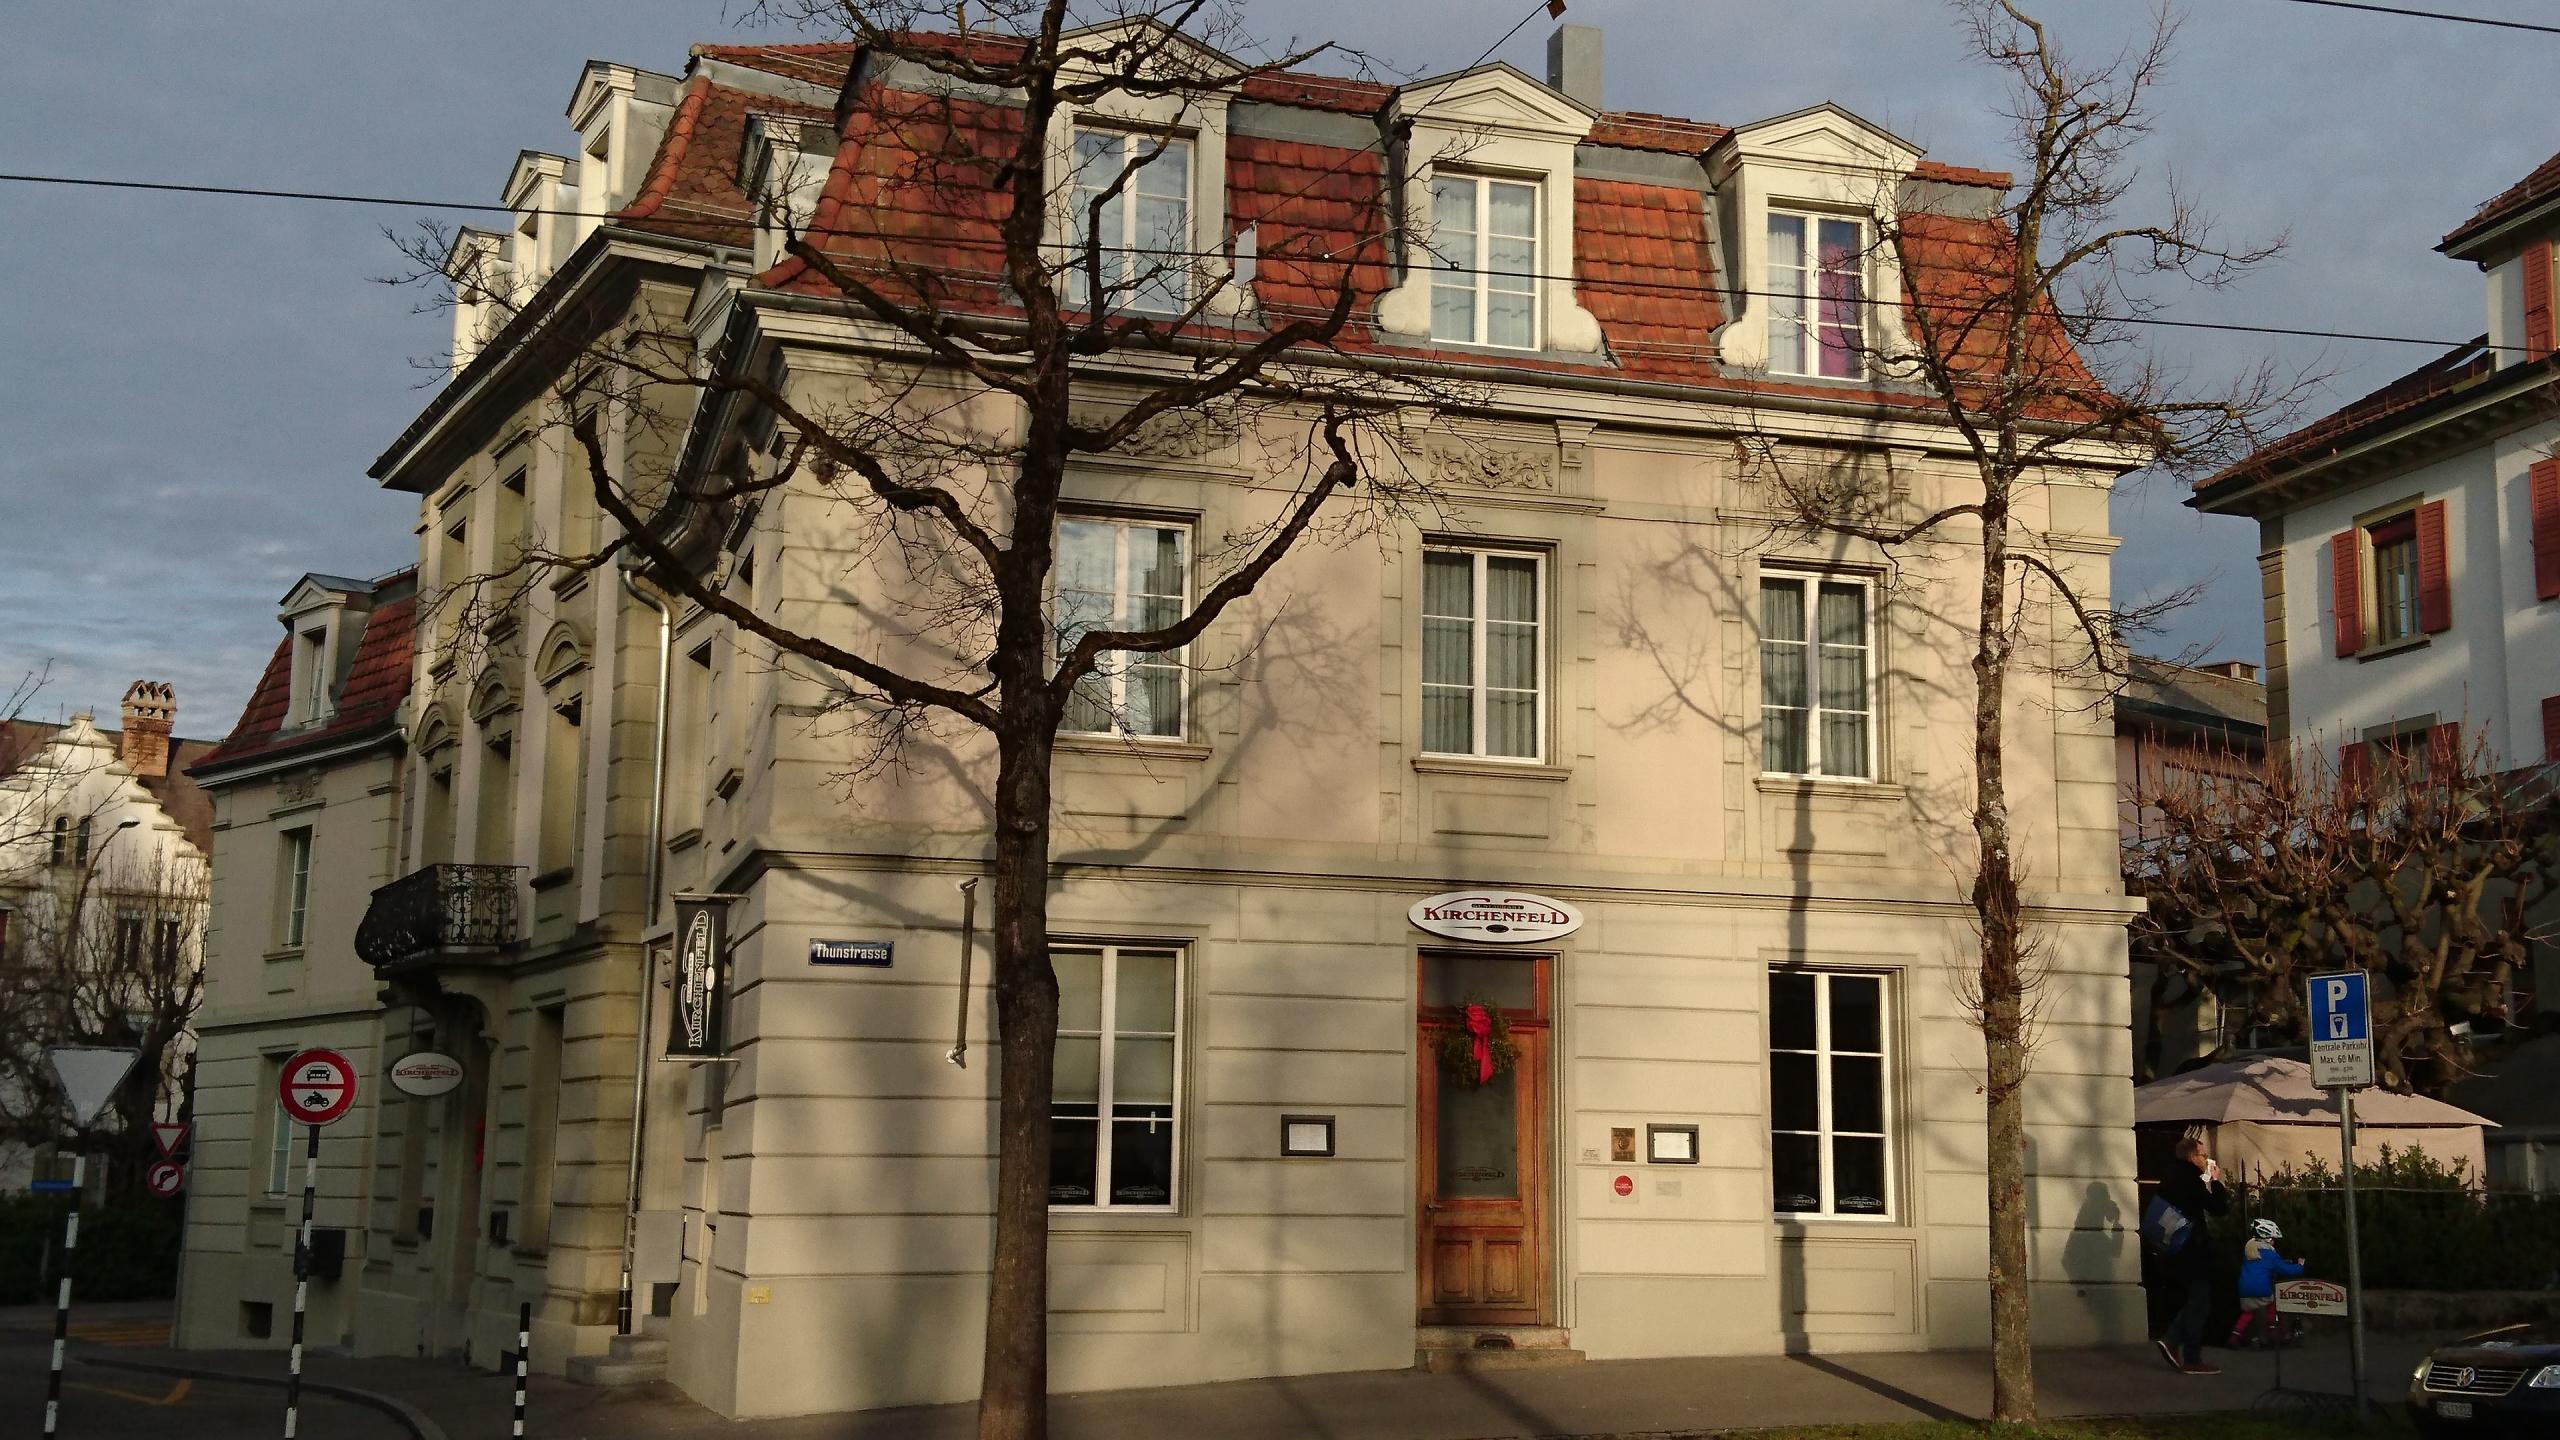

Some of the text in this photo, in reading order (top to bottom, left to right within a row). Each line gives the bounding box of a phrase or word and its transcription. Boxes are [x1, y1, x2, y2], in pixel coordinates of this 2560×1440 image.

[1424, 907, 1570, 925] KIRCHENFELD
[815, 943, 888, 960] Thunstrasse
[689, 912, 707, 1048] KIRCHENFELD
[2327, 980, 2348, 1013] P
[2313, 1040, 2368, 1053] Zentrale Parkuhr
[2320, 1053, 2362, 1065] Max. 60 Min.
[2280, 1289, 2344, 1303] KIRCHENFELD
